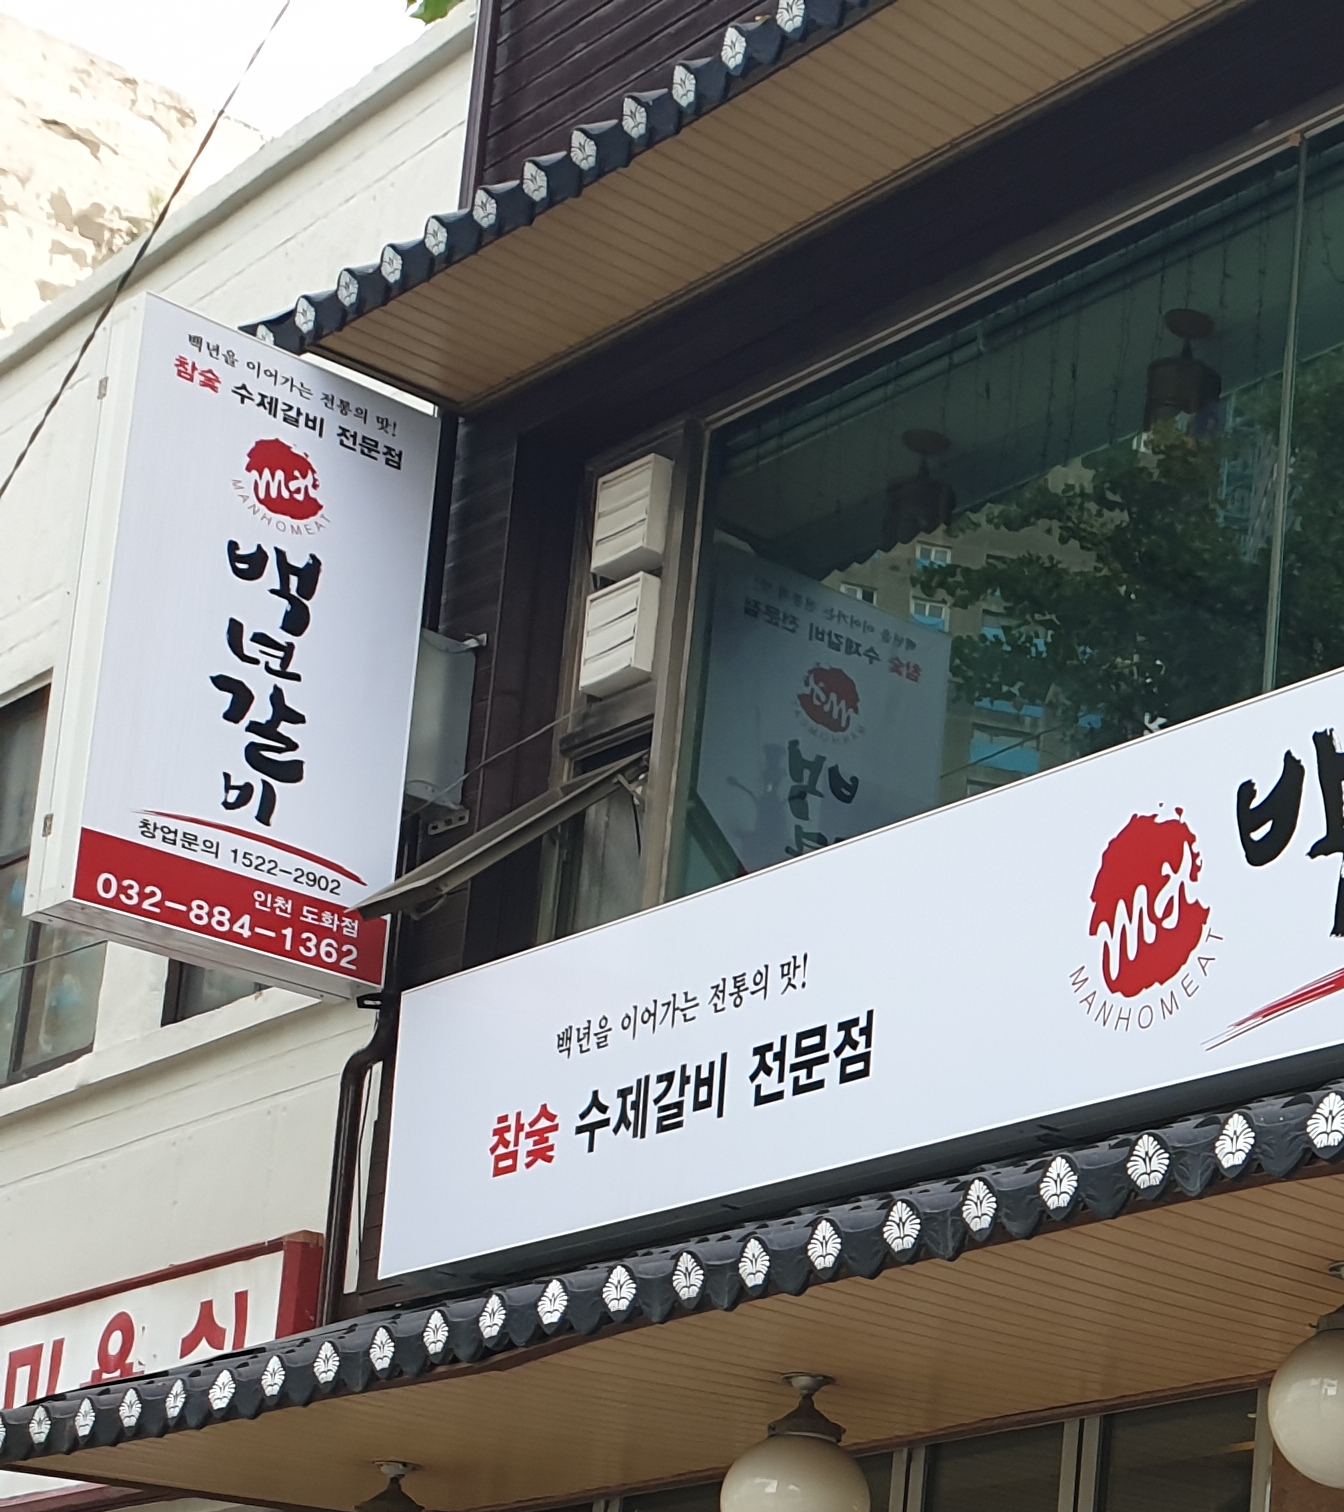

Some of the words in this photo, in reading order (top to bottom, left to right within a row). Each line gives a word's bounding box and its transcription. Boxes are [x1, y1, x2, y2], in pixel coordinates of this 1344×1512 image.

[174, 355, 221, 394] 참숯
[231, 383, 325, 439] 수제갈비
[337, 425, 403, 470] 전문점
[188, 334, 238, 367] 백년을
[246, 361, 313, 400] 이어가는
[320, 392, 368, 424] 전통의
[376, 415, 398, 437] 맛!
[230, 477, 332, 536] MANHOMEAT
[210, 538, 322, 827] 백년갈비
[138, 817, 220, 859] 창업문의
[230, 846, 341, 896] 1522-2902
[95, 873, 359, 971] 032-884-1362
[252, 887, 293, 915] 인천
[299, 899, 359, 938] 도화점
[555, 1017, 612, 1060] 백년을
[620, 993, 700, 1041] 이어가는
[708, 969, 770, 1013] 전통의
[778, 952, 809, 994] 맛!
[1069, 928, 1224, 1032] MANHOMEAT
[488, 1102, 560, 1178] 참숯
[573, 1052, 728, 1154] 수제갈비
[748, 1010, 877, 1107] 전문점
